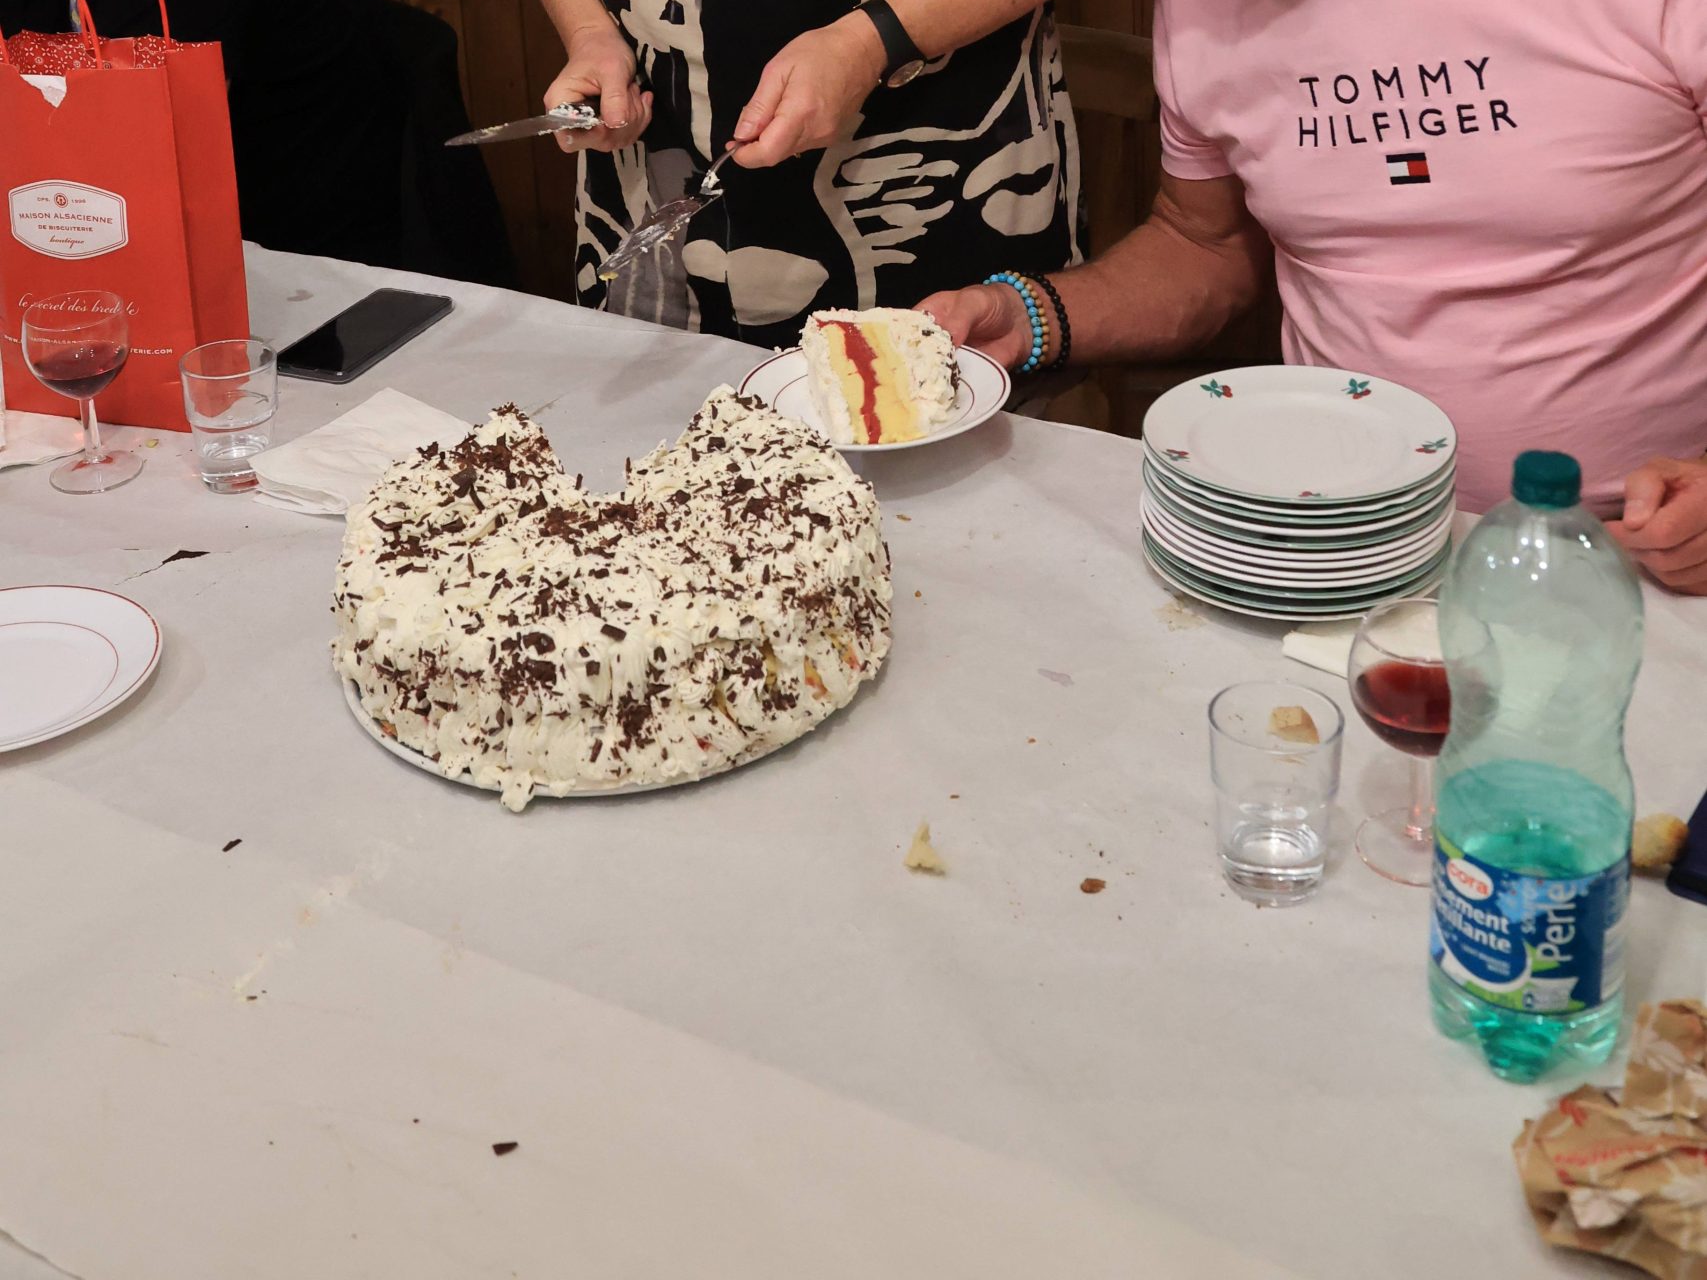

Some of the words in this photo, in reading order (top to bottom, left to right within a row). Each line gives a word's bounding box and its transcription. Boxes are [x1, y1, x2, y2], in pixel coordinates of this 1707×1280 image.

[1299, 56, 1490, 108] TOMMY
[1298, 99, 1518, 148] HILFIGER
[19, 212, 51, 220] MAISON
[53, 213, 113, 225] ALSACIENNE
[49, 234, 86, 249] boutique
[18, 292, 33, 308] le
[1448, 862, 1490, 897] cora
